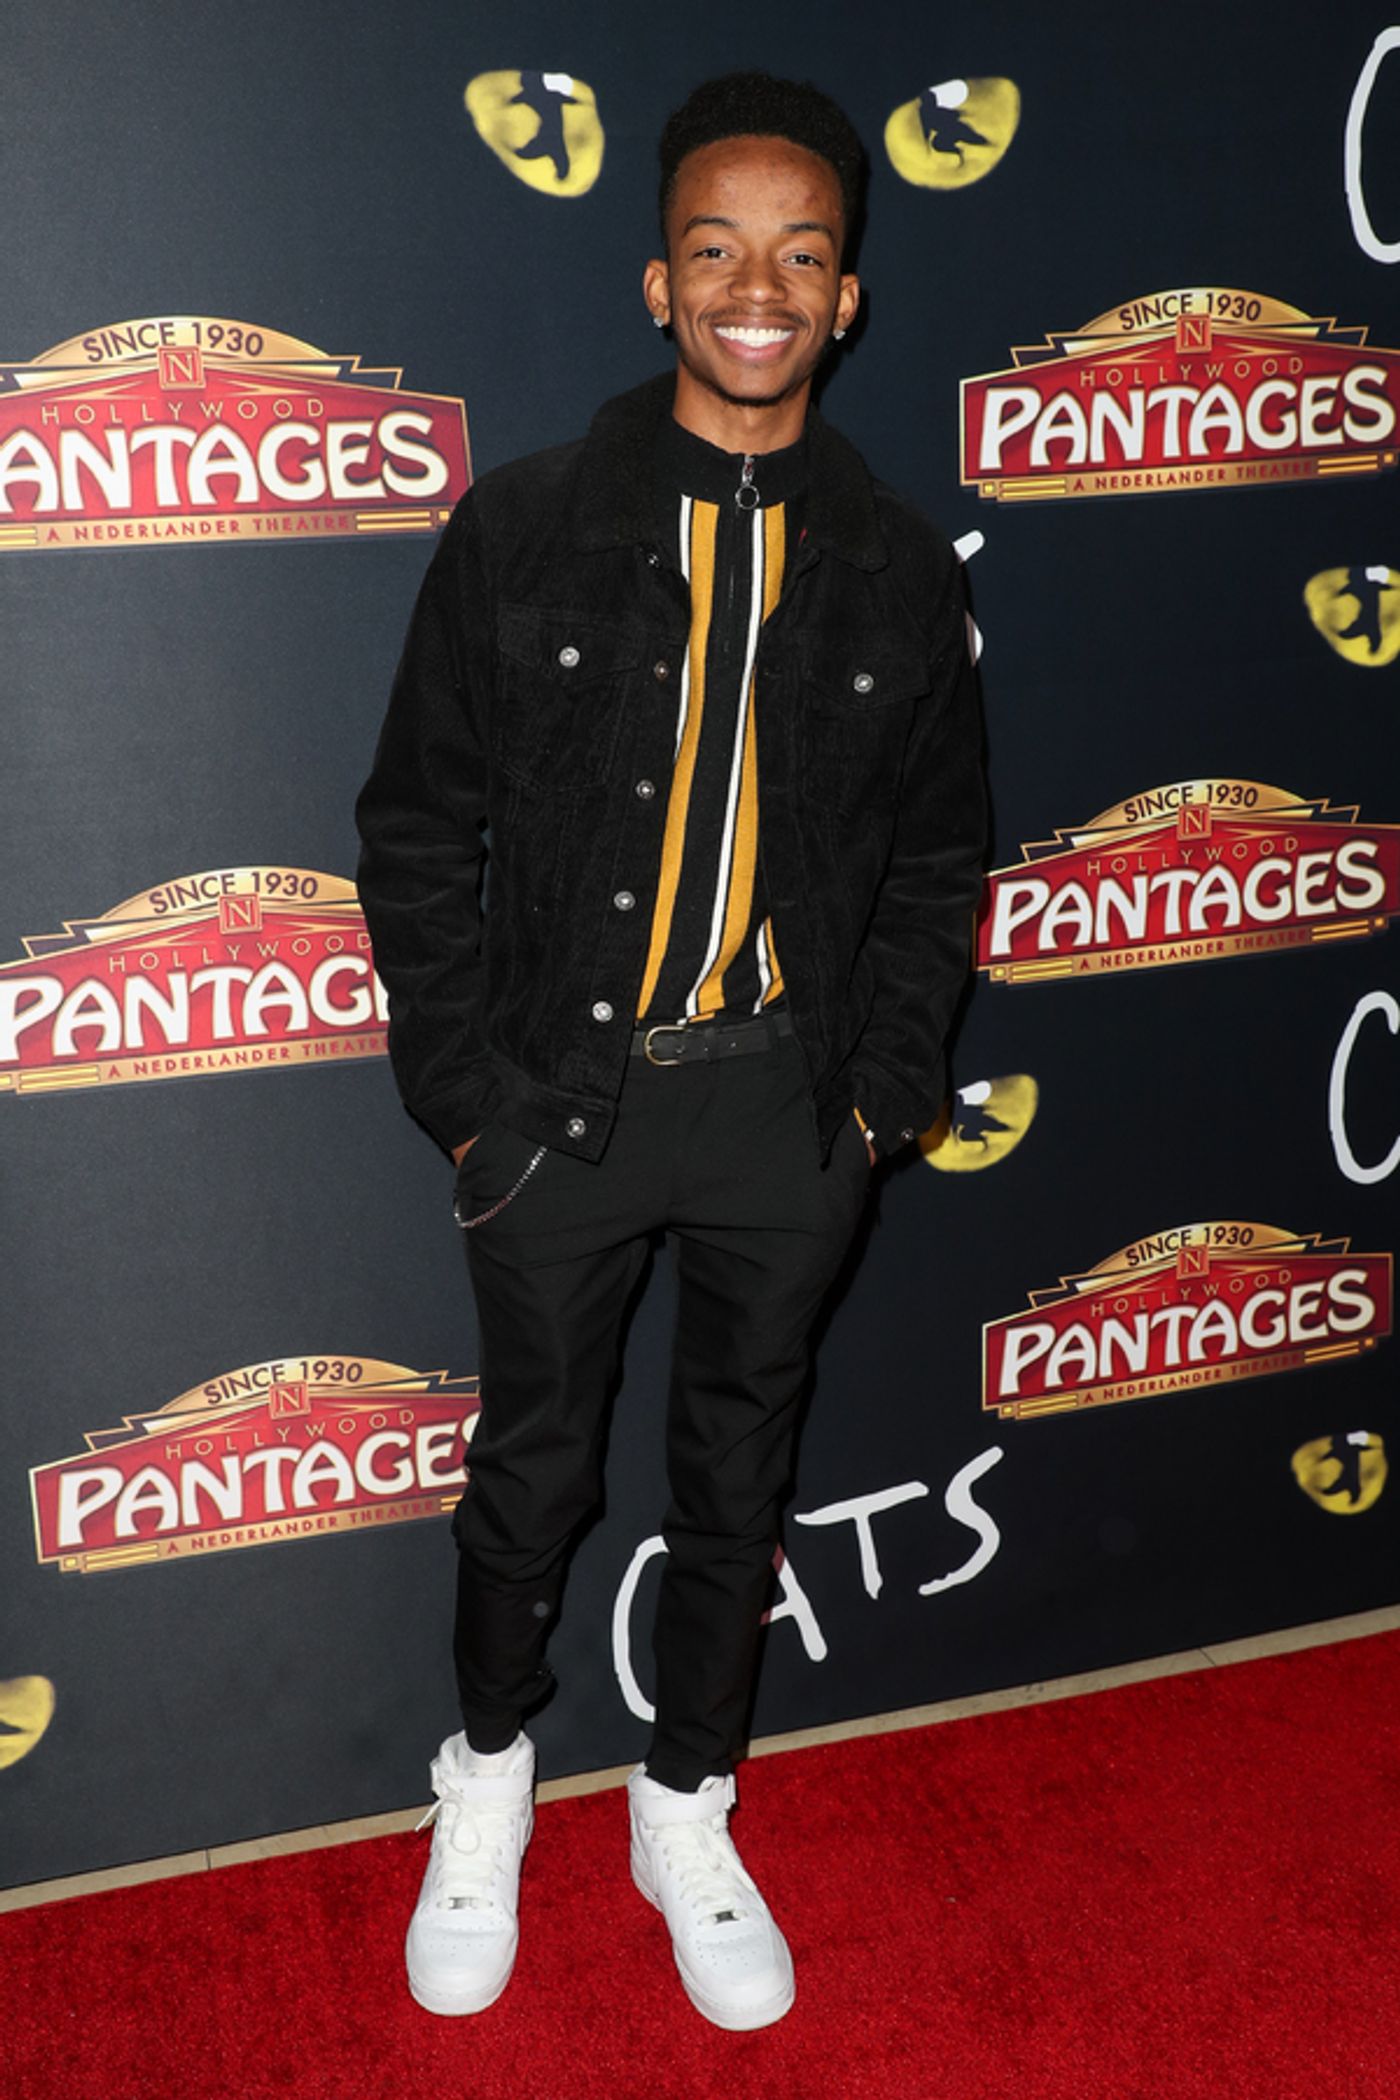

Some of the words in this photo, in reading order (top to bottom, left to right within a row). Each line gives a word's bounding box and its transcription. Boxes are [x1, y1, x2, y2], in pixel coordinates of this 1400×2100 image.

[1119, 293, 1193, 331] SINCE
[1206, 293, 1261, 321] 1930
[83, 322, 175, 362] SINCE
[192, 322, 264, 356] 1930
[1080, 357, 1303, 387] HOLLYWOOD
[41, 399, 324, 425] HOLLYWOOD
[979, 365, 1397, 471] PANTAGES
[1073, 480, 1084, 491] A
[1095, 469, 1226, 490] NEDERLANDER
[1236, 461, 1312, 480] THEATRE
[47, 529, 60, 542] A
[75, 519, 241, 540] NEDERLANDER
[253, 514, 349, 532] THEATRE
[1125, 785, 1194, 822] SINCE
[1206, 784, 1259, 808] 1930
[1088, 837, 1298, 876] HOLLYWOOD
[149, 873, 236, 914] SINCE
[252, 872, 318, 899] 1930
[989, 840, 1386, 957] PANTAGES
[109, 934, 371, 973] HOLLYWOOD
[1080, 959, 1090, 969] A
[1101, 940, 1224, 967] NEDERLANDER
[1234, 929, 1307, 950] THEATRE
[108, 1067, 121, 1078] A
[134, 1046, 291, 1076] NEDERLANDER
[1126, 1229, 1192, 1267] SINCE
[1203, 1226, 1255, 1247] 1930
[1091, 1269, 1291, 1317] HOLLYWOOD
[999, 1269, 1376, 1395] PANTAGES
[204, 1363, 285, 1404] SINCE
[300, 1360, 363, 1383] 1930
[1084, 1393, 1094, 1403] A
[1104, 1368, 1221, 1400] NEDERLANDER
[1230, 1354, 1300, 1376] THEATRE
[166, 1409, 415, 1460] HOLLYWOOD
[167, 1542, 179, 1554] A
[191, 1517, 338, 1550] NEDERLANDER
[349, 1501, 433, 1525] THEATRE
